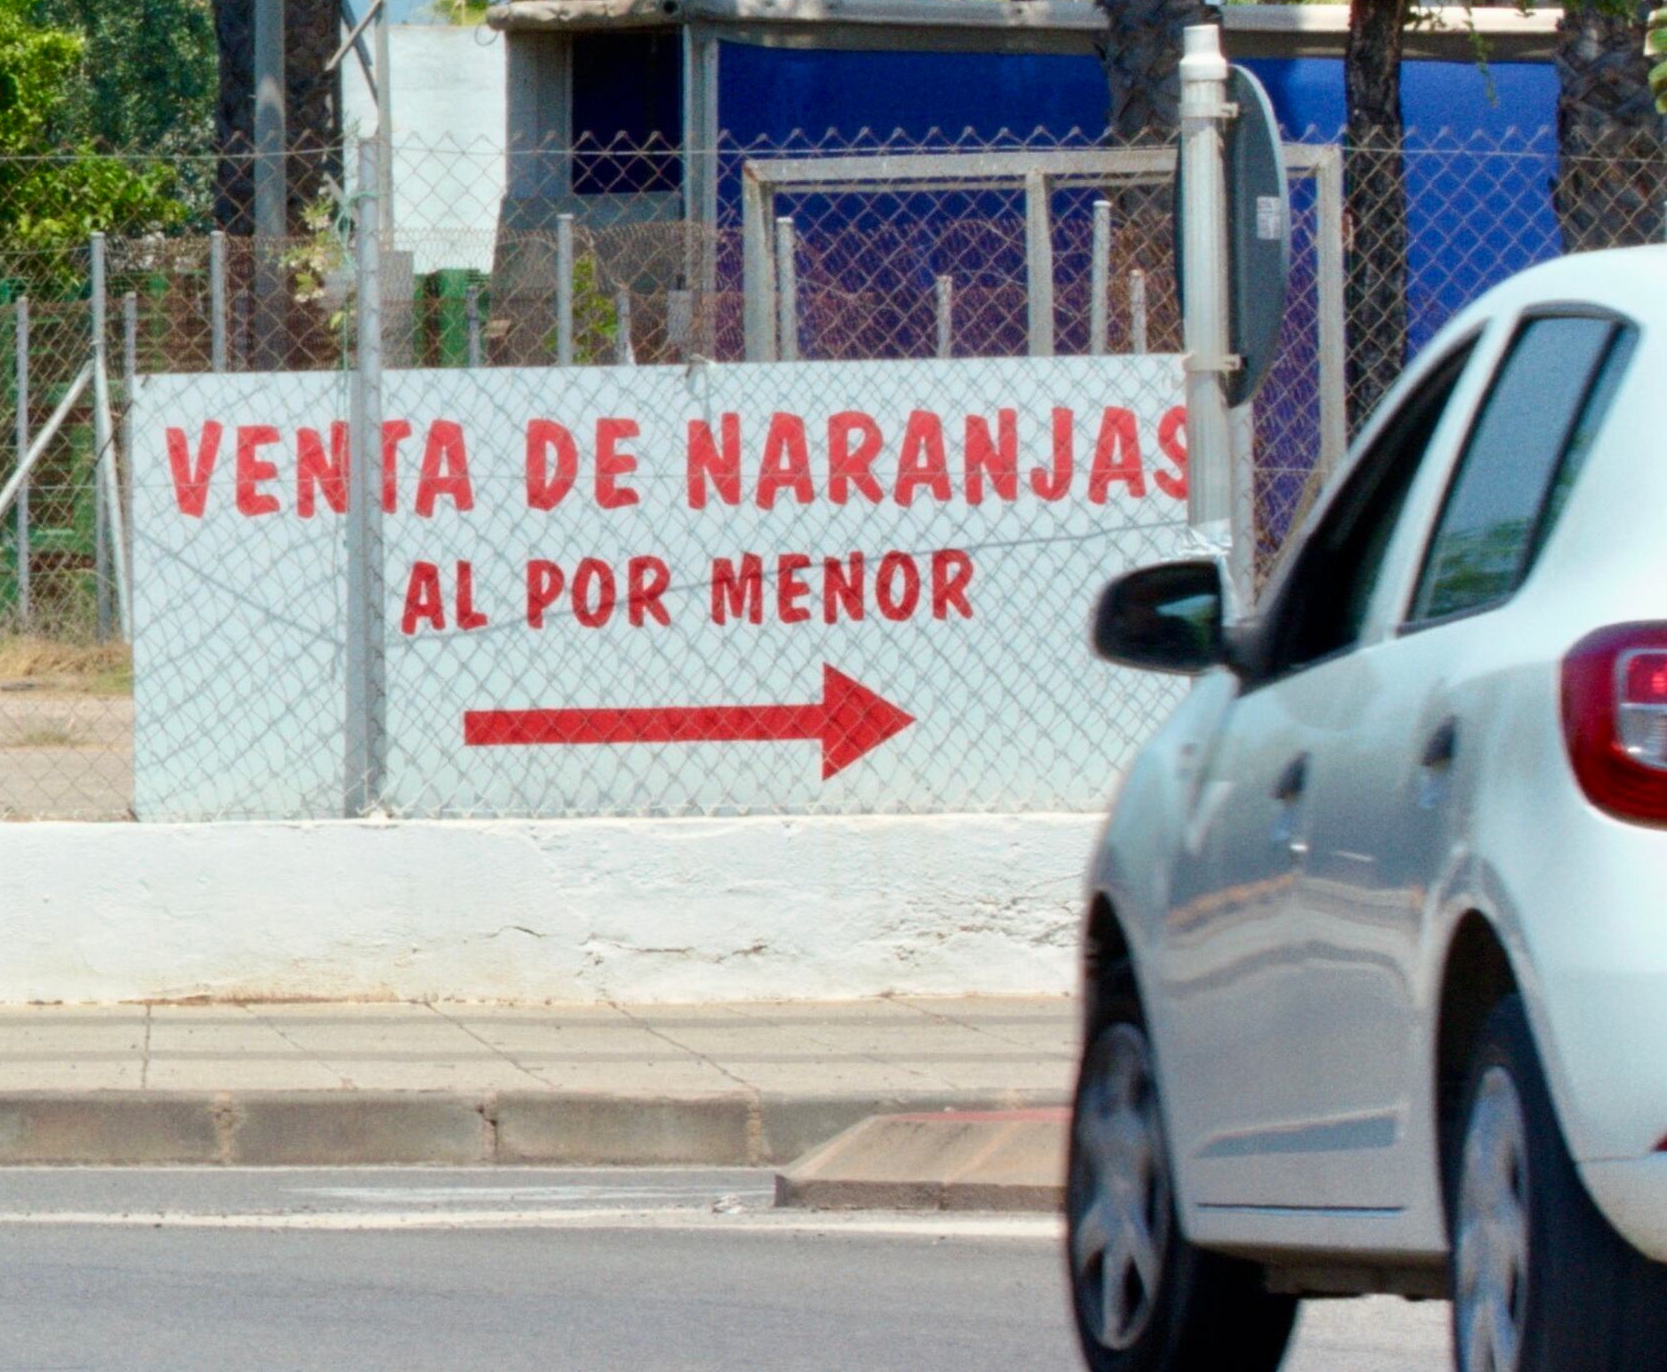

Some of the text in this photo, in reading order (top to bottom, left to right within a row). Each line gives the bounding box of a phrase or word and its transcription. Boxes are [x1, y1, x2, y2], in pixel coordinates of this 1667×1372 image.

[165, 405, 1189, 518] VENTA DE NARANJAS
[401, 549, 973, 634] AL POR MENOR
